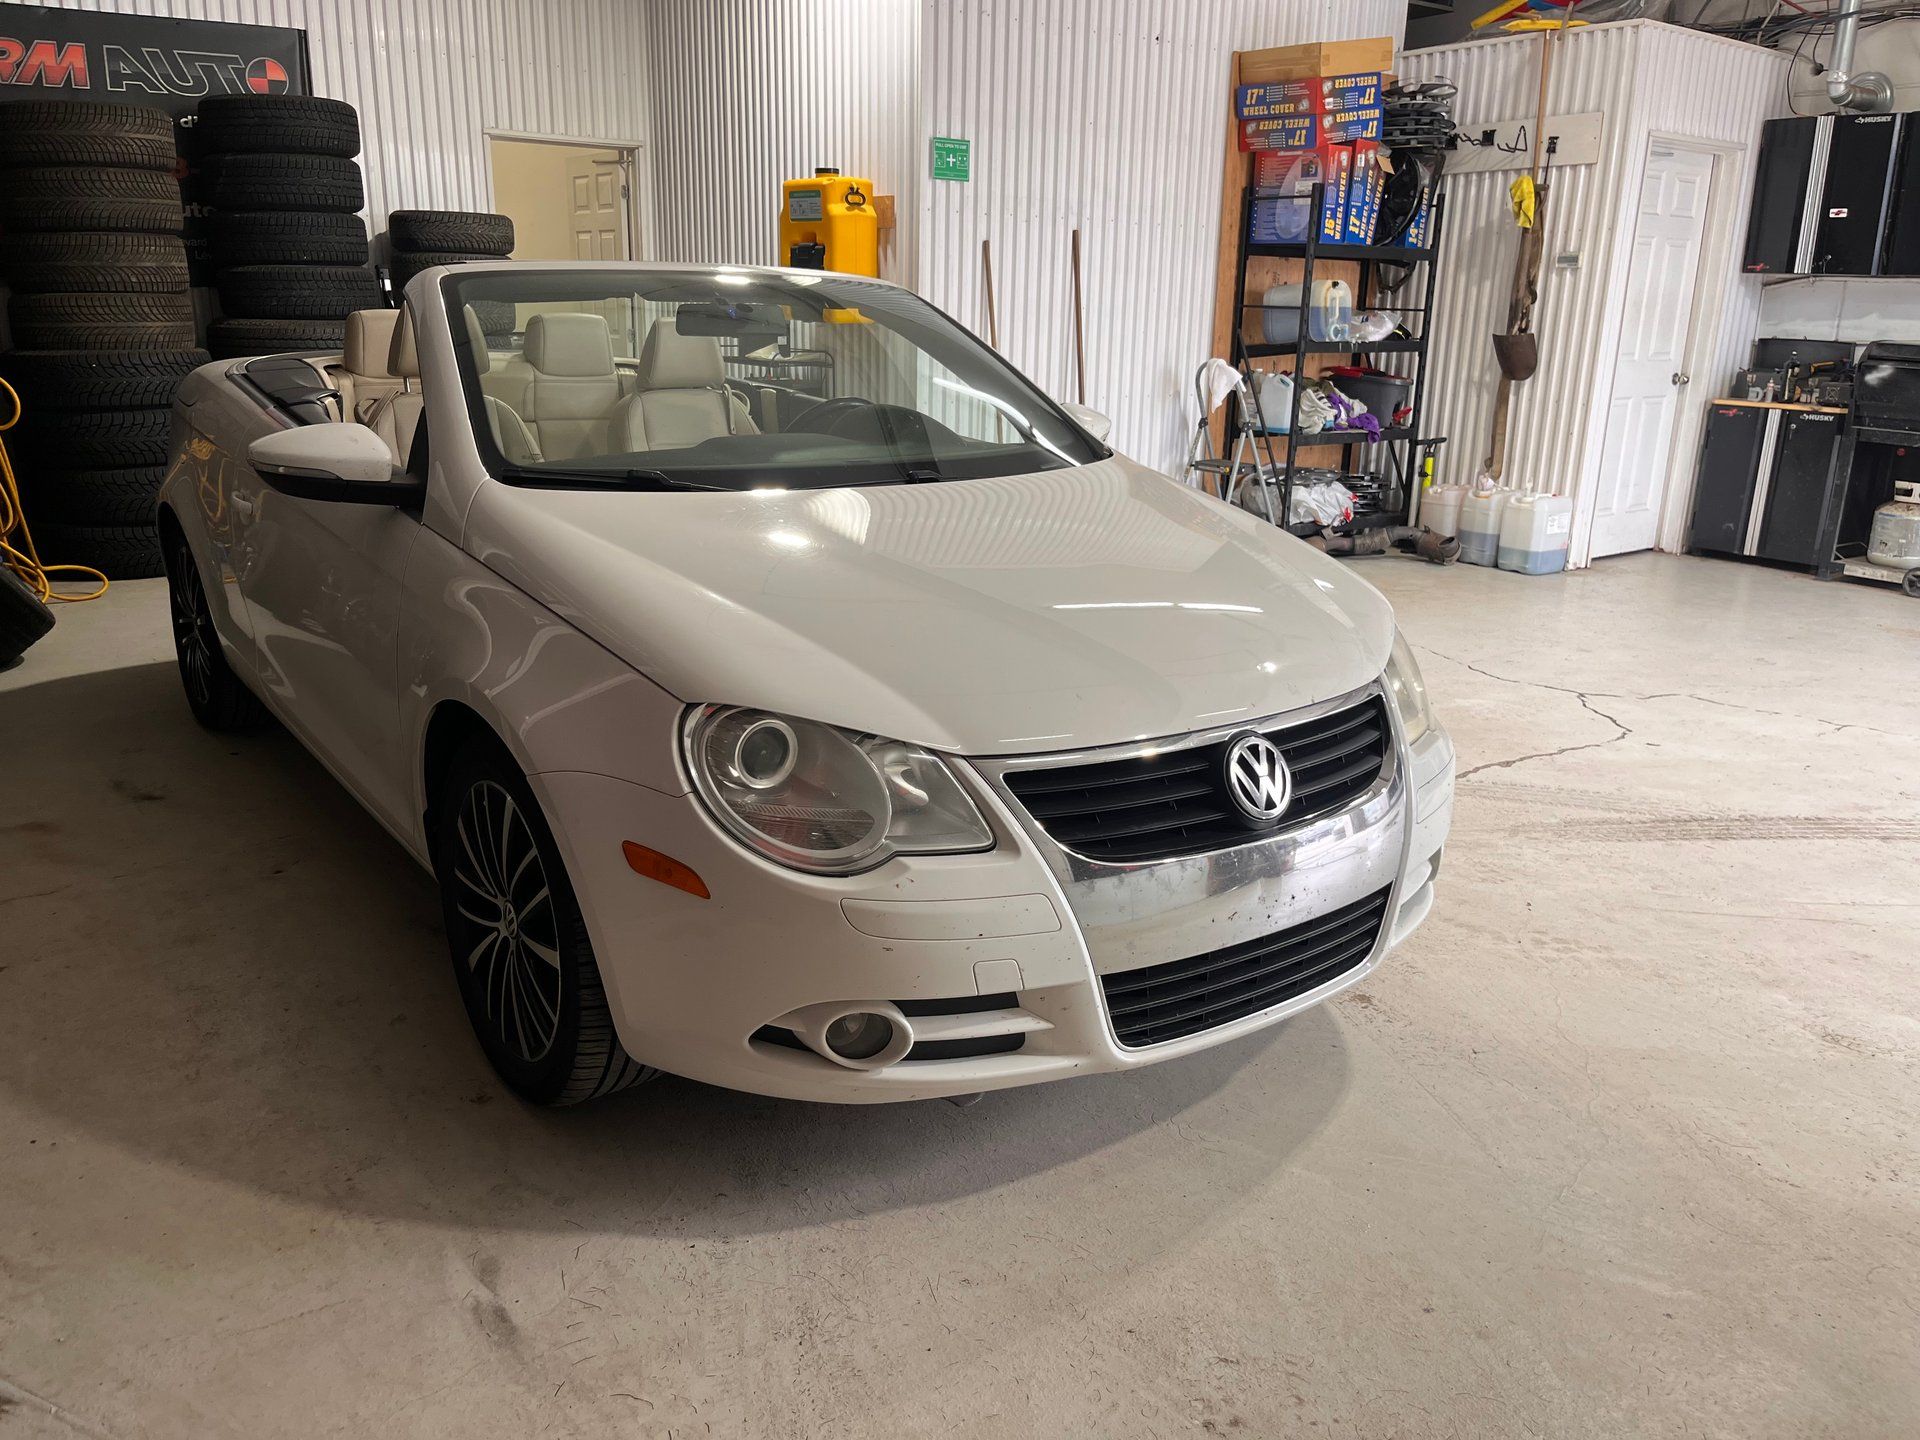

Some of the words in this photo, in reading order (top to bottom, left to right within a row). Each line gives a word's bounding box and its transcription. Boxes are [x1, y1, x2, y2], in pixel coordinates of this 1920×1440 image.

[1335, 78, 1355, 88] COVER
[1356, 76, 1377, 86] WHEEL
[1246, 88, 1264, 105] 17"
[1243, 106, 1268, 116] WHEEL
[1270, 104, 1294, 114] COVER
[1358, 109, 1379, 120] WHEEL
[1336, 111, 1357, 122] COVER
[1865, 115, 1892, 123] HUSKY
[1259, 120, 1282, 130] COVER
[1285, 118, 1310, 128] WHEEL
[1288, 130, 1306, 145] 17"
[1338, 171, 1347, 204] COVER
[1359, 204, 1369, 238] WHEEL
[1365, 169, 1374, 202] COVER
[1421, 187, 1430, 216] COVER
[1366, 211, 1377, 245] WHEEL
[1373, 178, 1384, 210] COVER
[1335, 205, 1344, 239] WHEEL
[1417, 217, 1426, 248] WHEEL
[1808, 414, 1834, 422] HUSKY
